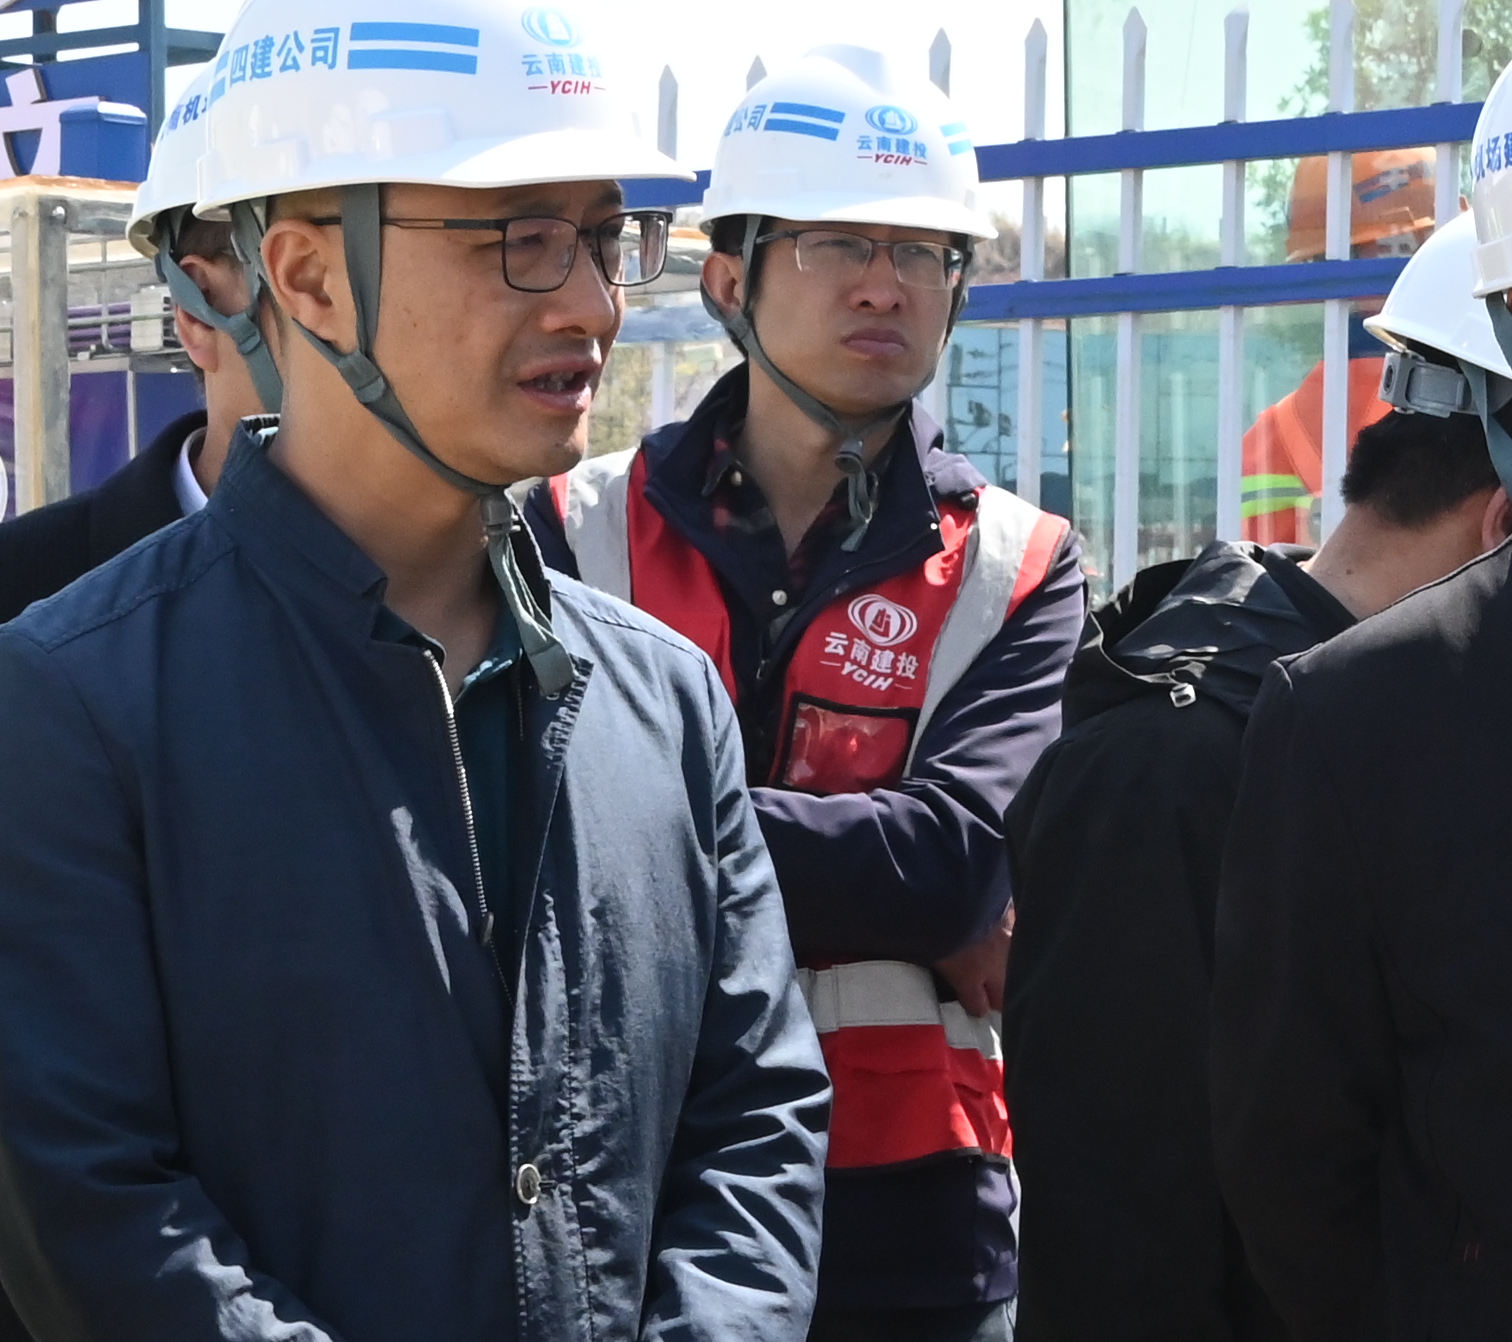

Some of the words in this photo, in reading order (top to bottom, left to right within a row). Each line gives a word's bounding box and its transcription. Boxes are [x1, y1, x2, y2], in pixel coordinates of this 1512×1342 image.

[229, 26, 340, 89] 四建公司
[550, 80, 591, 95] YCIH
[856, 135, 928, 159] 云南建投
[874, 153, 914, 167] YCIH
[823, 631, 920, 680] 云南建投
[841, 661, 894, 691] YCIH
